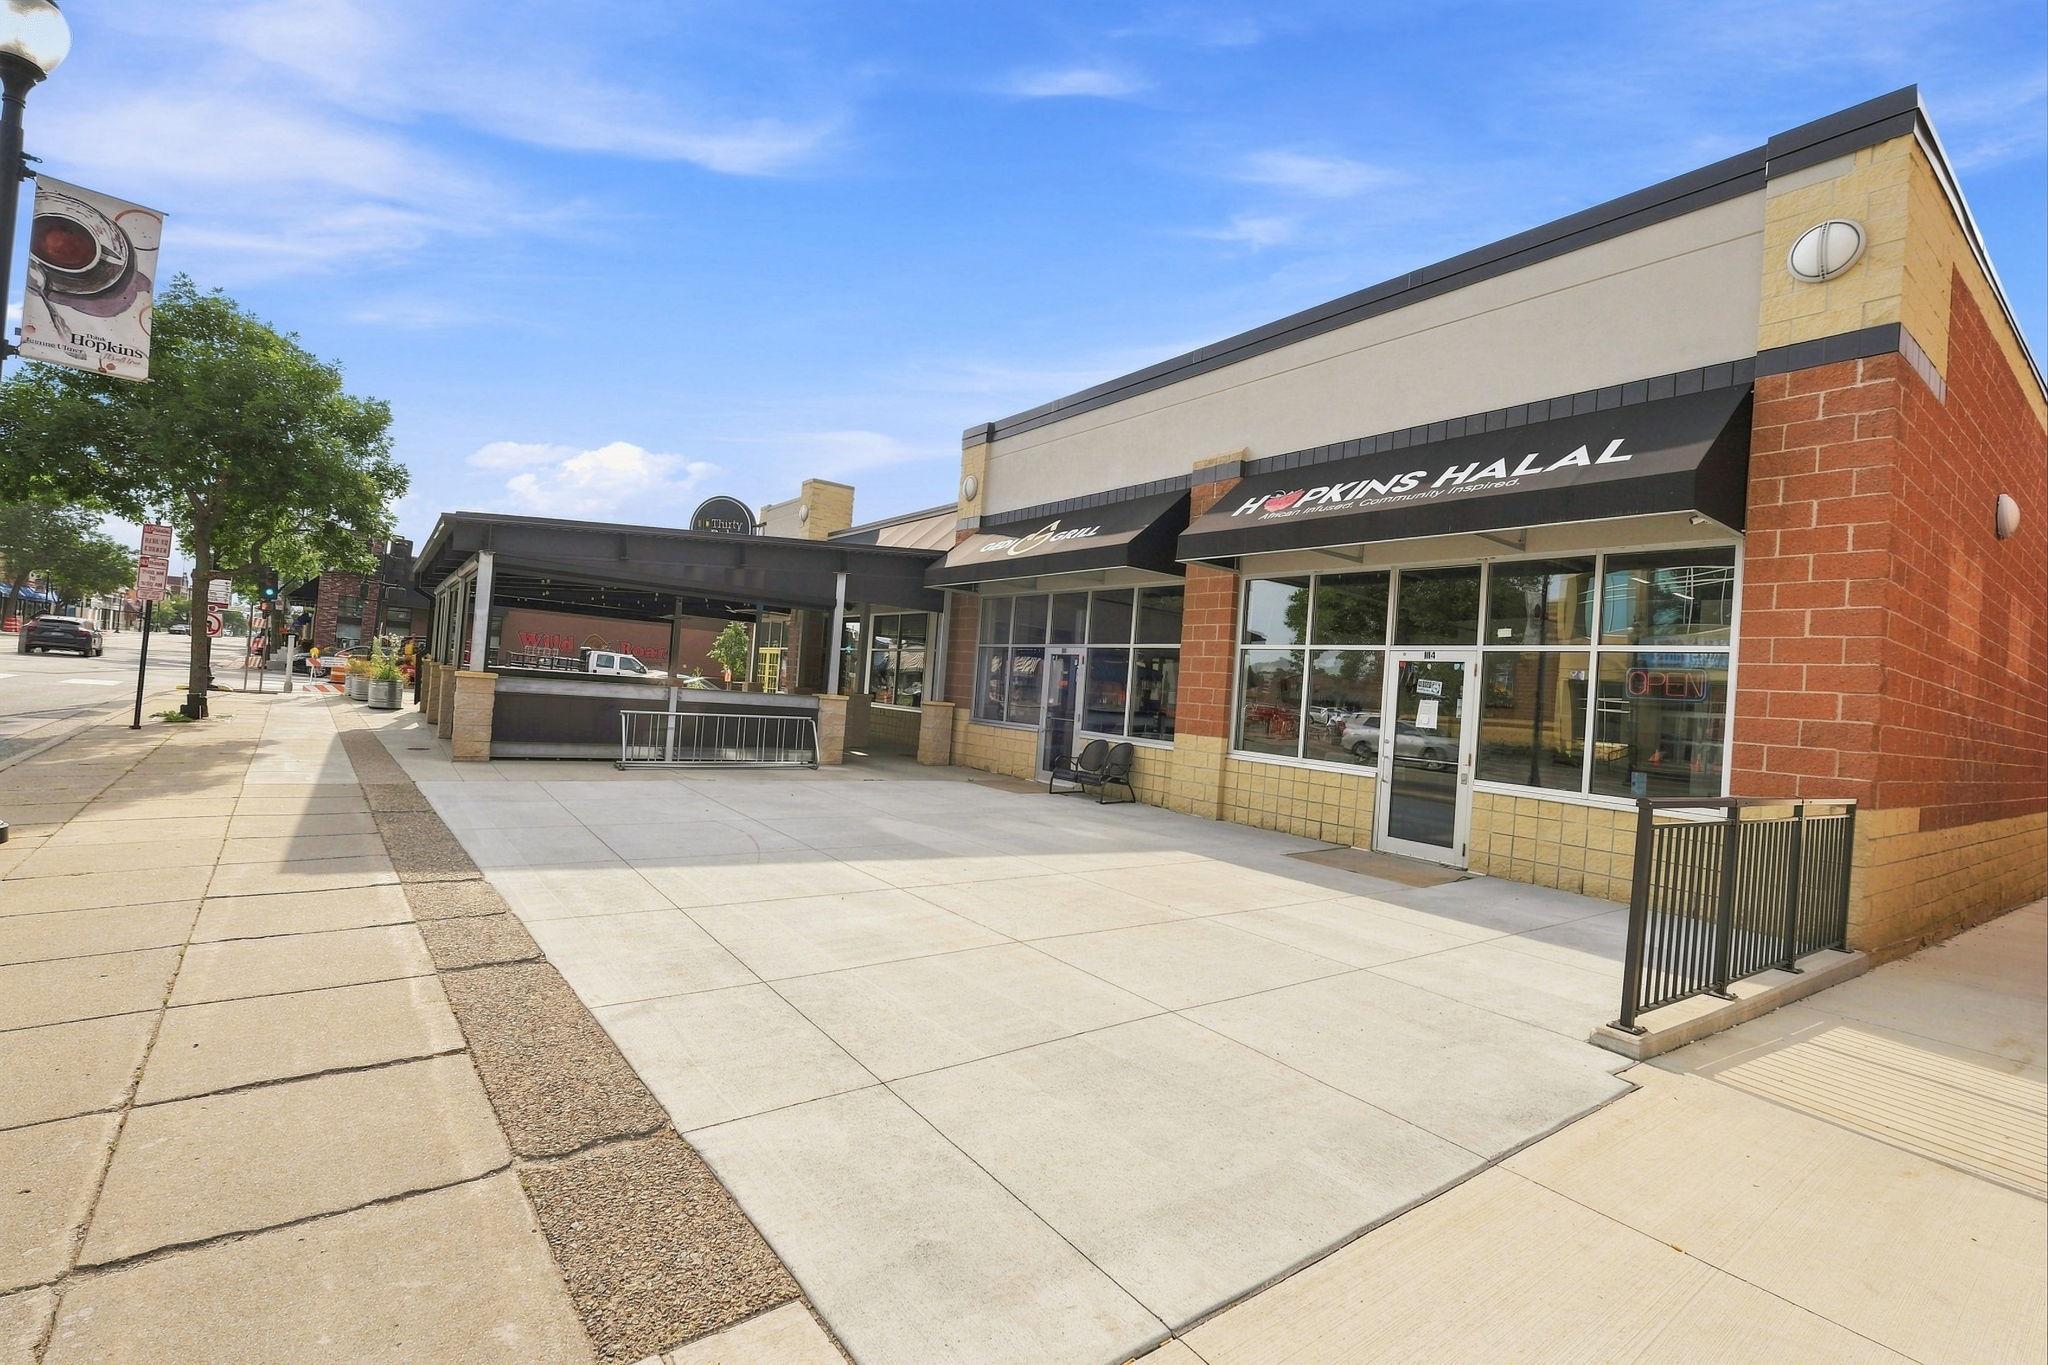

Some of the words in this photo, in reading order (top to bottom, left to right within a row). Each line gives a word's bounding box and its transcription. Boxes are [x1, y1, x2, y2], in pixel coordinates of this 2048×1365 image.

[70, 333, 143, 359] Hopkins
[1431, 438, 1633, 489] HALAL
[1258, 507, 1304, 521] African
[1360, 488, 1444, 508] Community
[1448, 478, 1520, 495] Inspired.
[711, 518, 743, 532] Thirty
[1050, 525, 1101, 542] GRILL
[518, 630, 574, 652] Wild
[1628, 670, 1704, 698] OPEN
